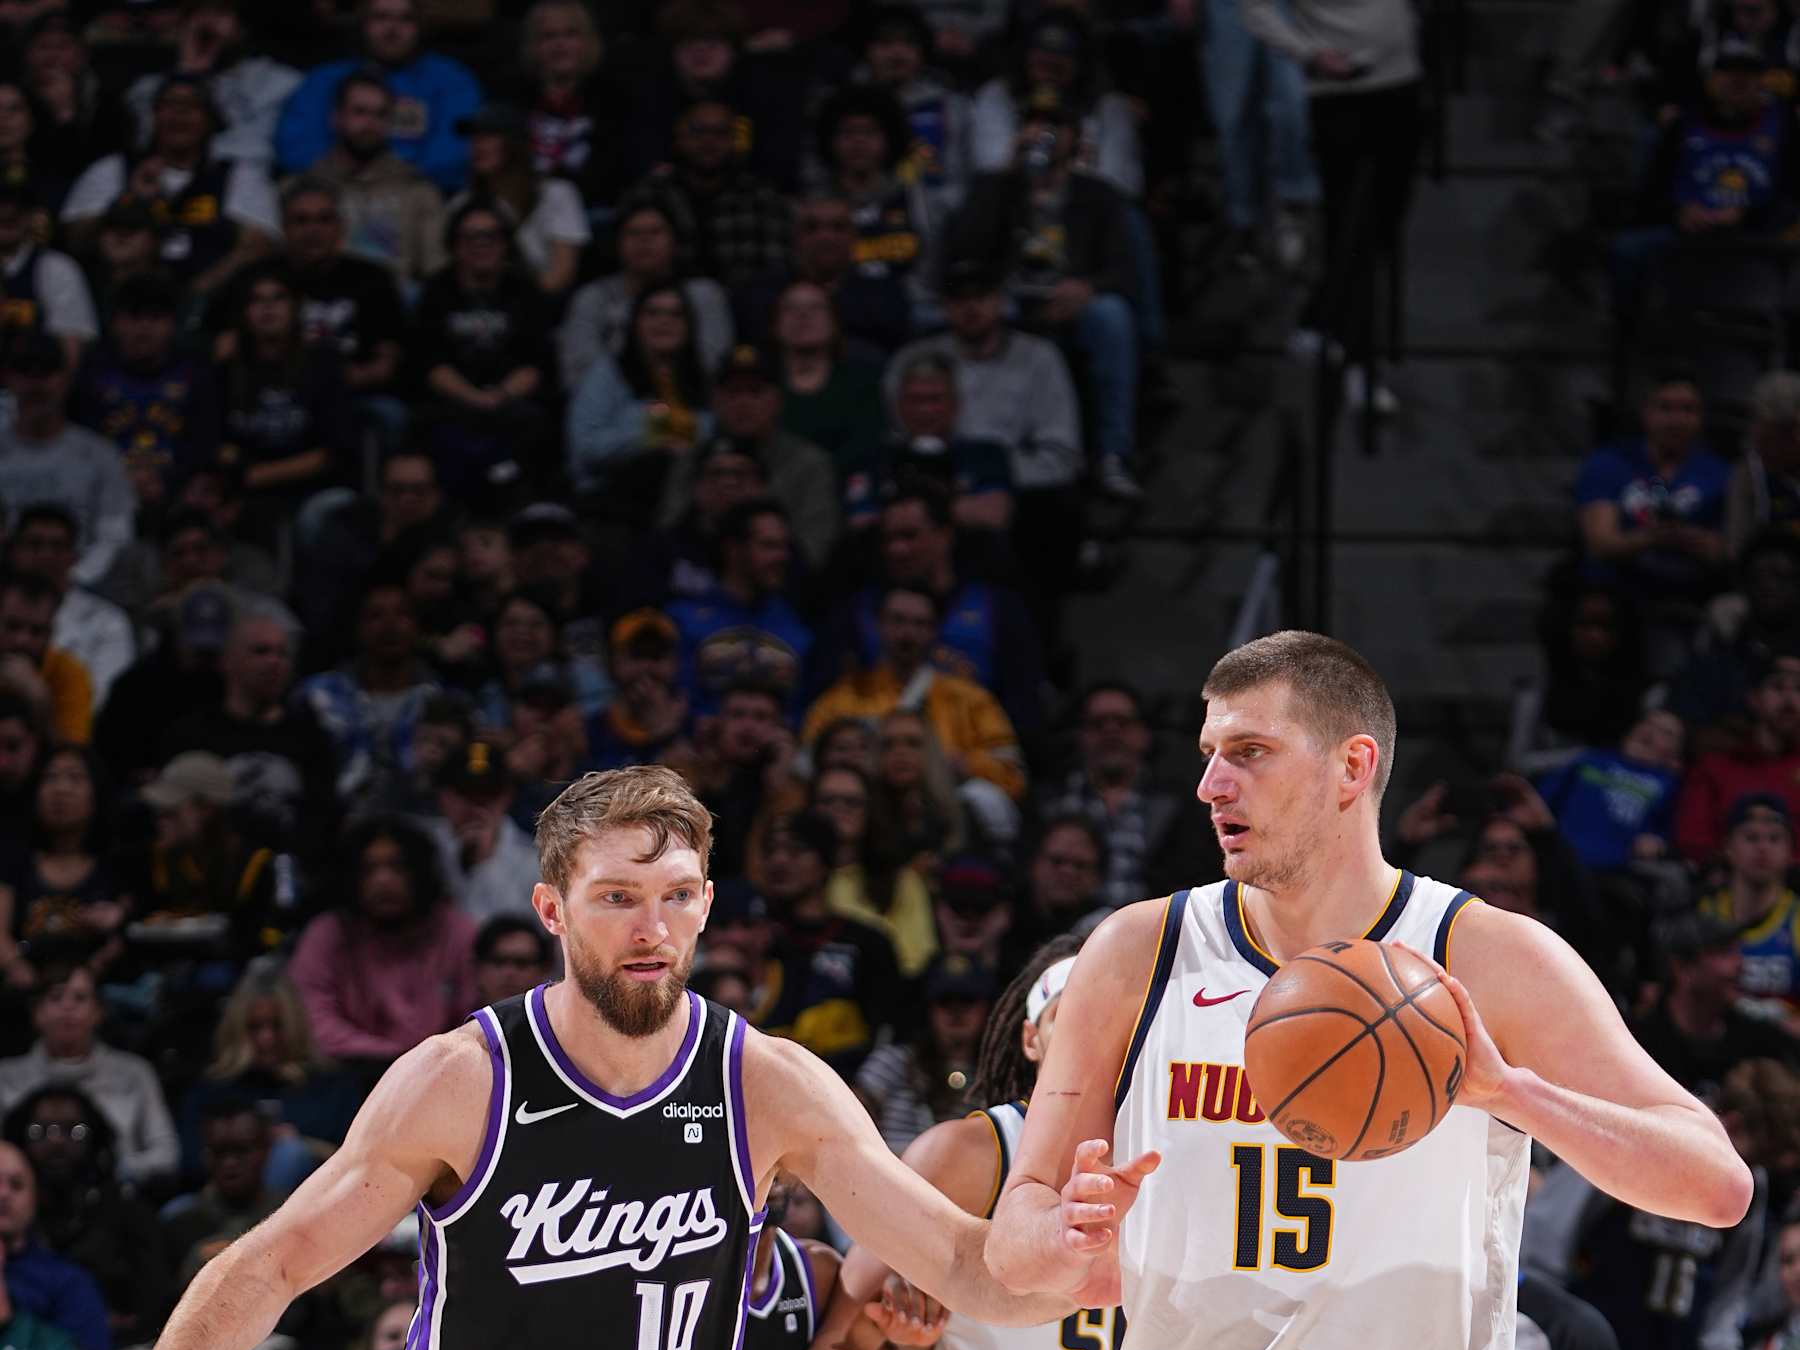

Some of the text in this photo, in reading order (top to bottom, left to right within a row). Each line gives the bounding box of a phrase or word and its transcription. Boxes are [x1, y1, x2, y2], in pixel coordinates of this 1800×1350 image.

[662, 1102, 724, 1122] dialpad
[499, 1178, 728, 1285] Kings
[1230, 1142, 1336, 1273] 15
